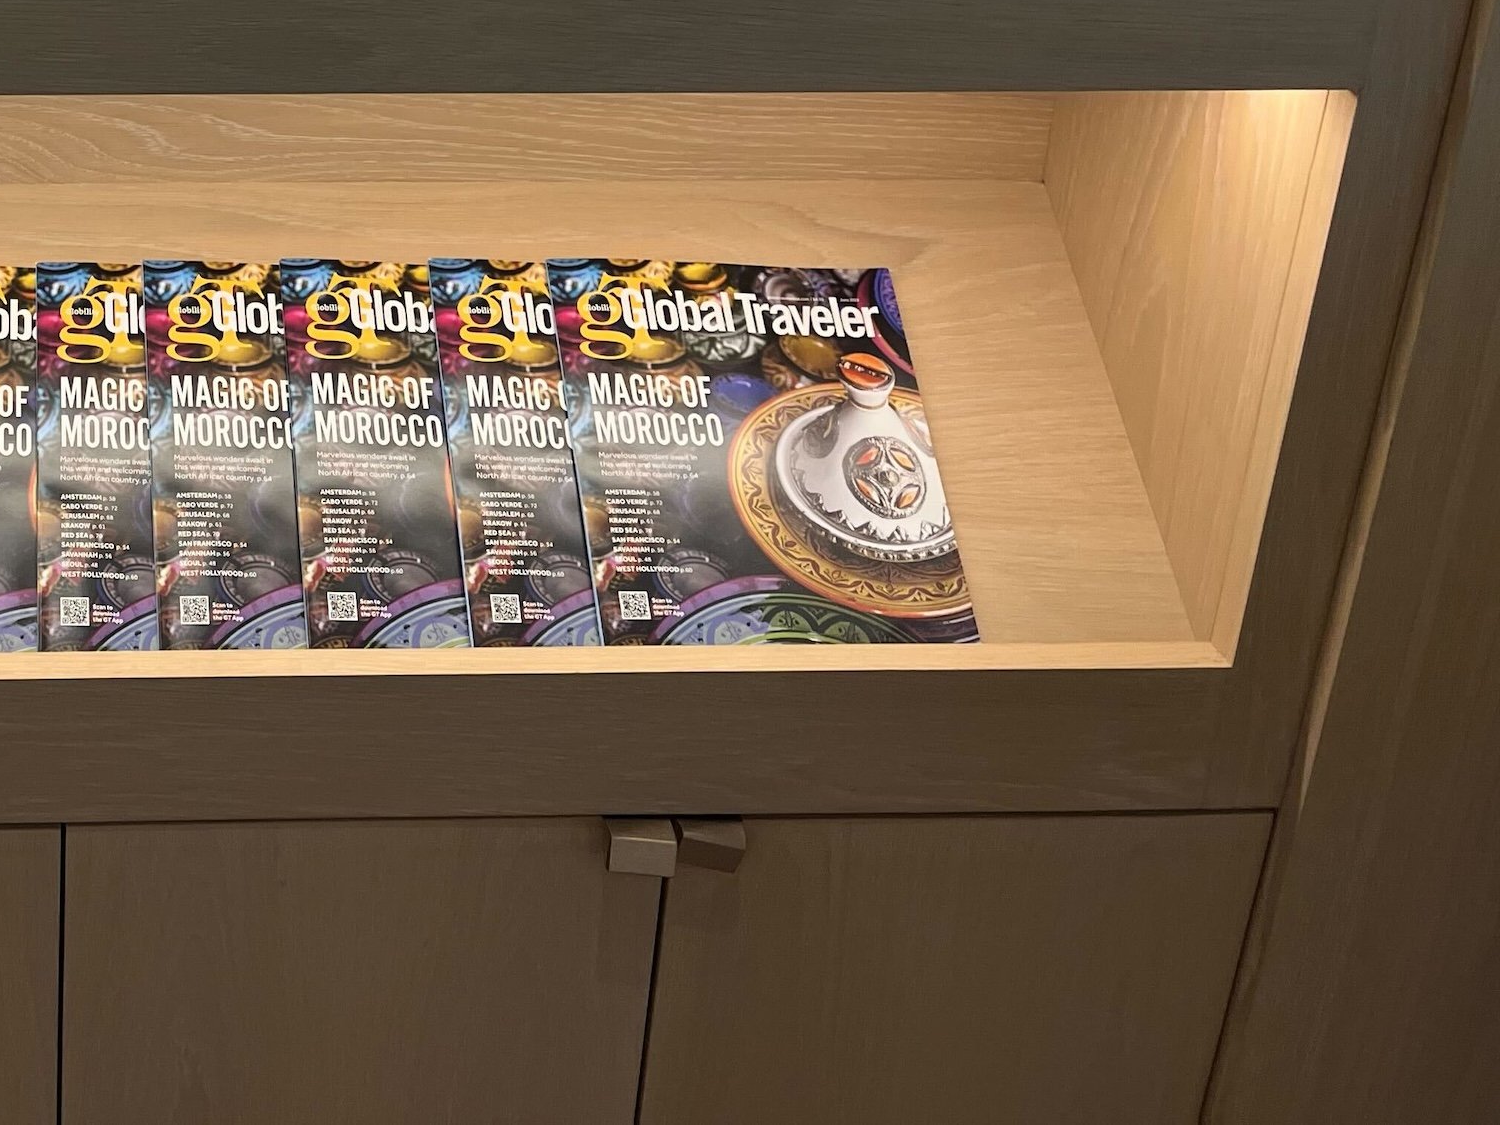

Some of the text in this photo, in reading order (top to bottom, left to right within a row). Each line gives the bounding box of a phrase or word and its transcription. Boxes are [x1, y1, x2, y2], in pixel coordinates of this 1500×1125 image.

[621, 288, 880, 339] Global Traveler
[60, 376, 144, 412] MAGIC
[171, 374, 256, 411] MAGIC
[311, 372, 434, 410] MAGIC OF
[465, 374, 559, 411] MAGIC
[587, 372, 711, 408] MAGIC OF
[314, 410, 444, 448] MOROCCO
[593, 410, 724, 447] MOROCCO
